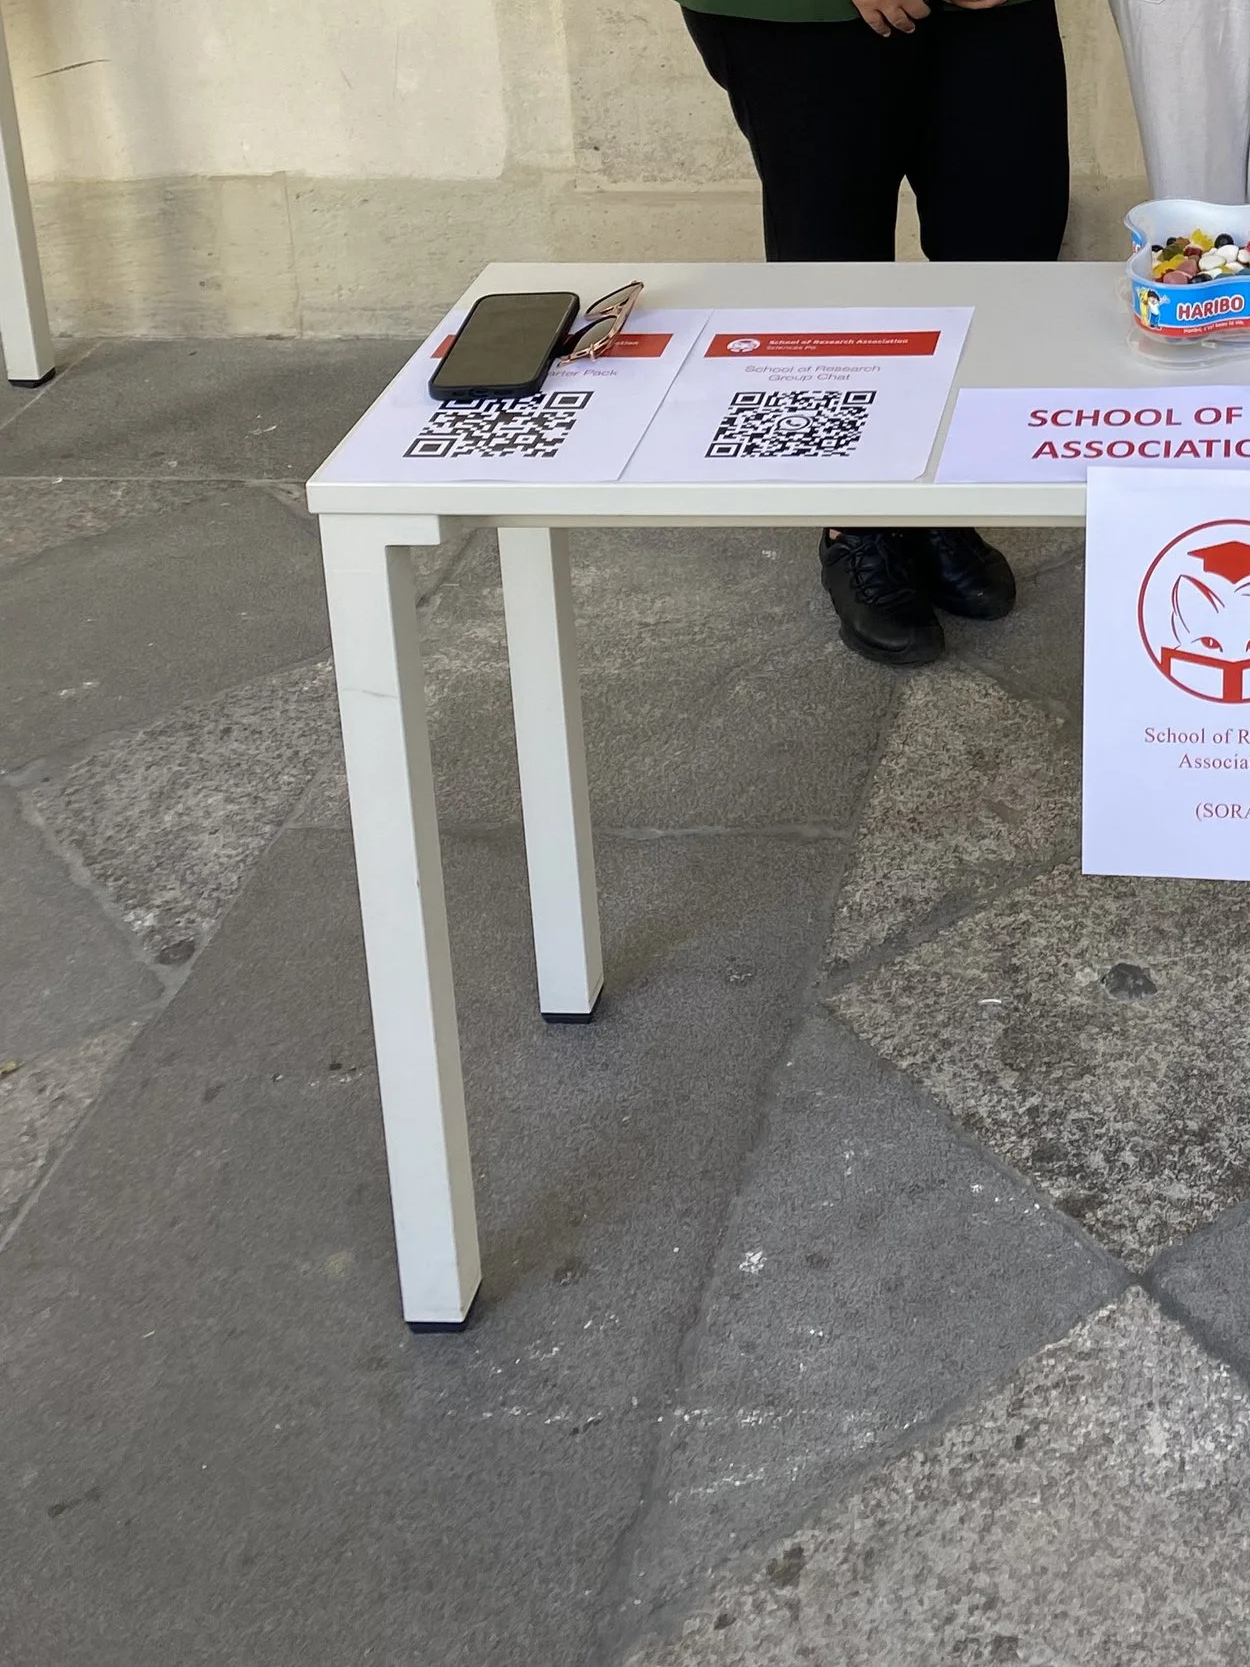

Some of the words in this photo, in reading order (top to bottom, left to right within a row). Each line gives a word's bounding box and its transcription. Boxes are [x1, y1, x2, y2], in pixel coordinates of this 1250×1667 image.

[1177, 295, 1244, 320] HARIBO
[548, 368, 578, 377] arter
[583, 368, 618, 377] Pack
[744, 365, 795, 373] School
[797, 365, 813, 373] of
[815, 365, 881, 373] Research
[768, 373, 813, 382] Group
[816, 373, 851, 382] Chat
[1027, 408, 1182, 428] SCHOOL
[1193, 406, 1244, 426] OF
[1144, 727, 1205, 744] School
[1212, 728, 1233, 744] of
